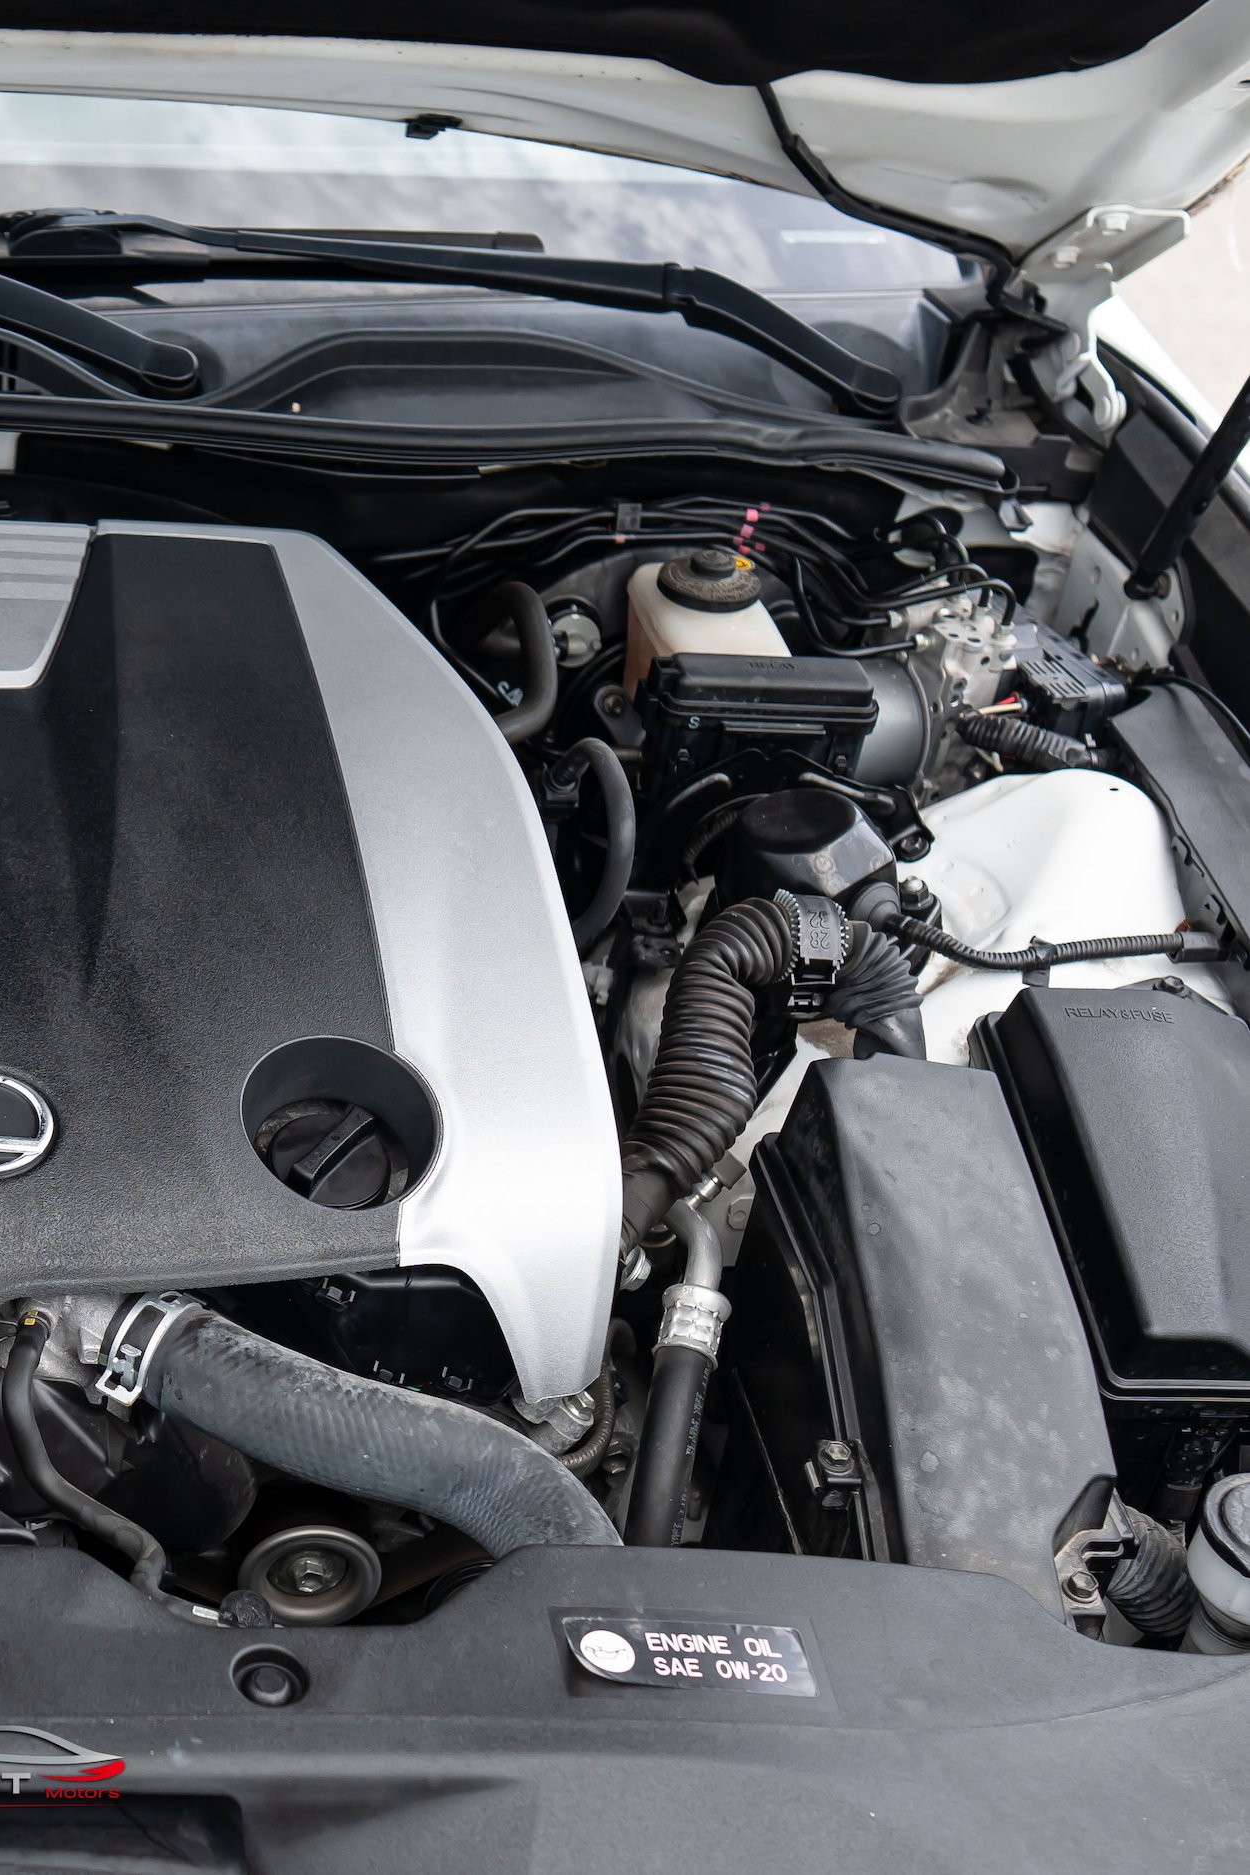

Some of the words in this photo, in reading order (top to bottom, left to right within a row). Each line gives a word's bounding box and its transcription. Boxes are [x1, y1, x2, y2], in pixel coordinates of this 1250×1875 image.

[644, 1632, 732, 1655] ENGINE
[743, 1637, 783, 1658] OIL
[653, 1656, 703, 1678] SAE
